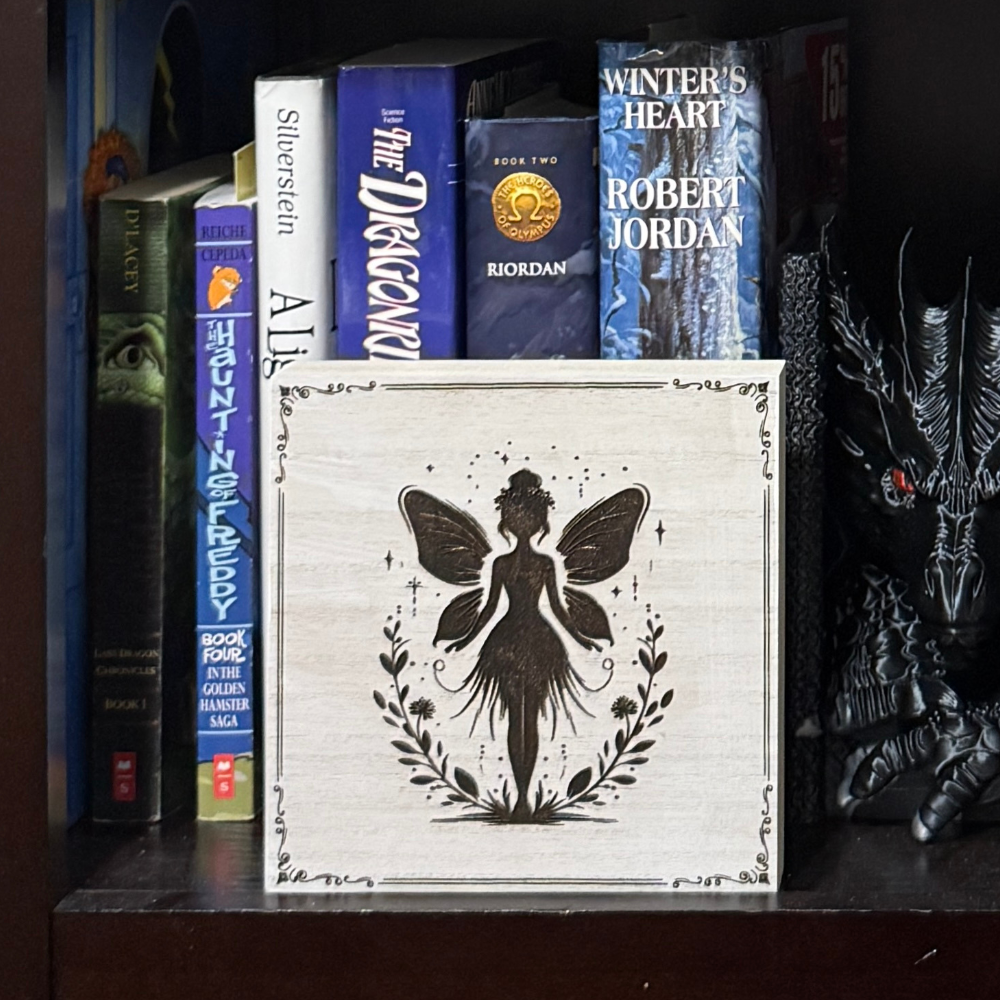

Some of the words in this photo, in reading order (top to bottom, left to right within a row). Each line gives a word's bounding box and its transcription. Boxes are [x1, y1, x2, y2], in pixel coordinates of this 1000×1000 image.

[603, 65, 747, 97] WINTER'S
[624, 100, 727, 130] HEART
[373, 127, 412, 173] THE
[494, 157, 526, 166] BOOK
[532, 156, 558, 165] TWO
[277, 107, 300, 236] Silverstein
[607, 176, 746, 211] ROBERT
[202, 224, 248, 240] REICHE
[499, 214, 512, 230] OF
[510, 213, 556, 239] OLYMPUS
[608, 215, 745, 251] JORDAN
[487, 260, 567, 277] RIORDAN
[270, 288, 315, 319] A
[206, 498, 241, 621] FREDDY
[201, 628, 247, 648] BOOK
[203, 646, 246, 664] FOUR
[207, 666, 219, 680] IN
[219, 665, 242, 679] THE
[203, 681, 246, 697] GOLDEN
[200, 697, 250, 713] HAMSTER
[209, 714, 239, 729] SAGA
